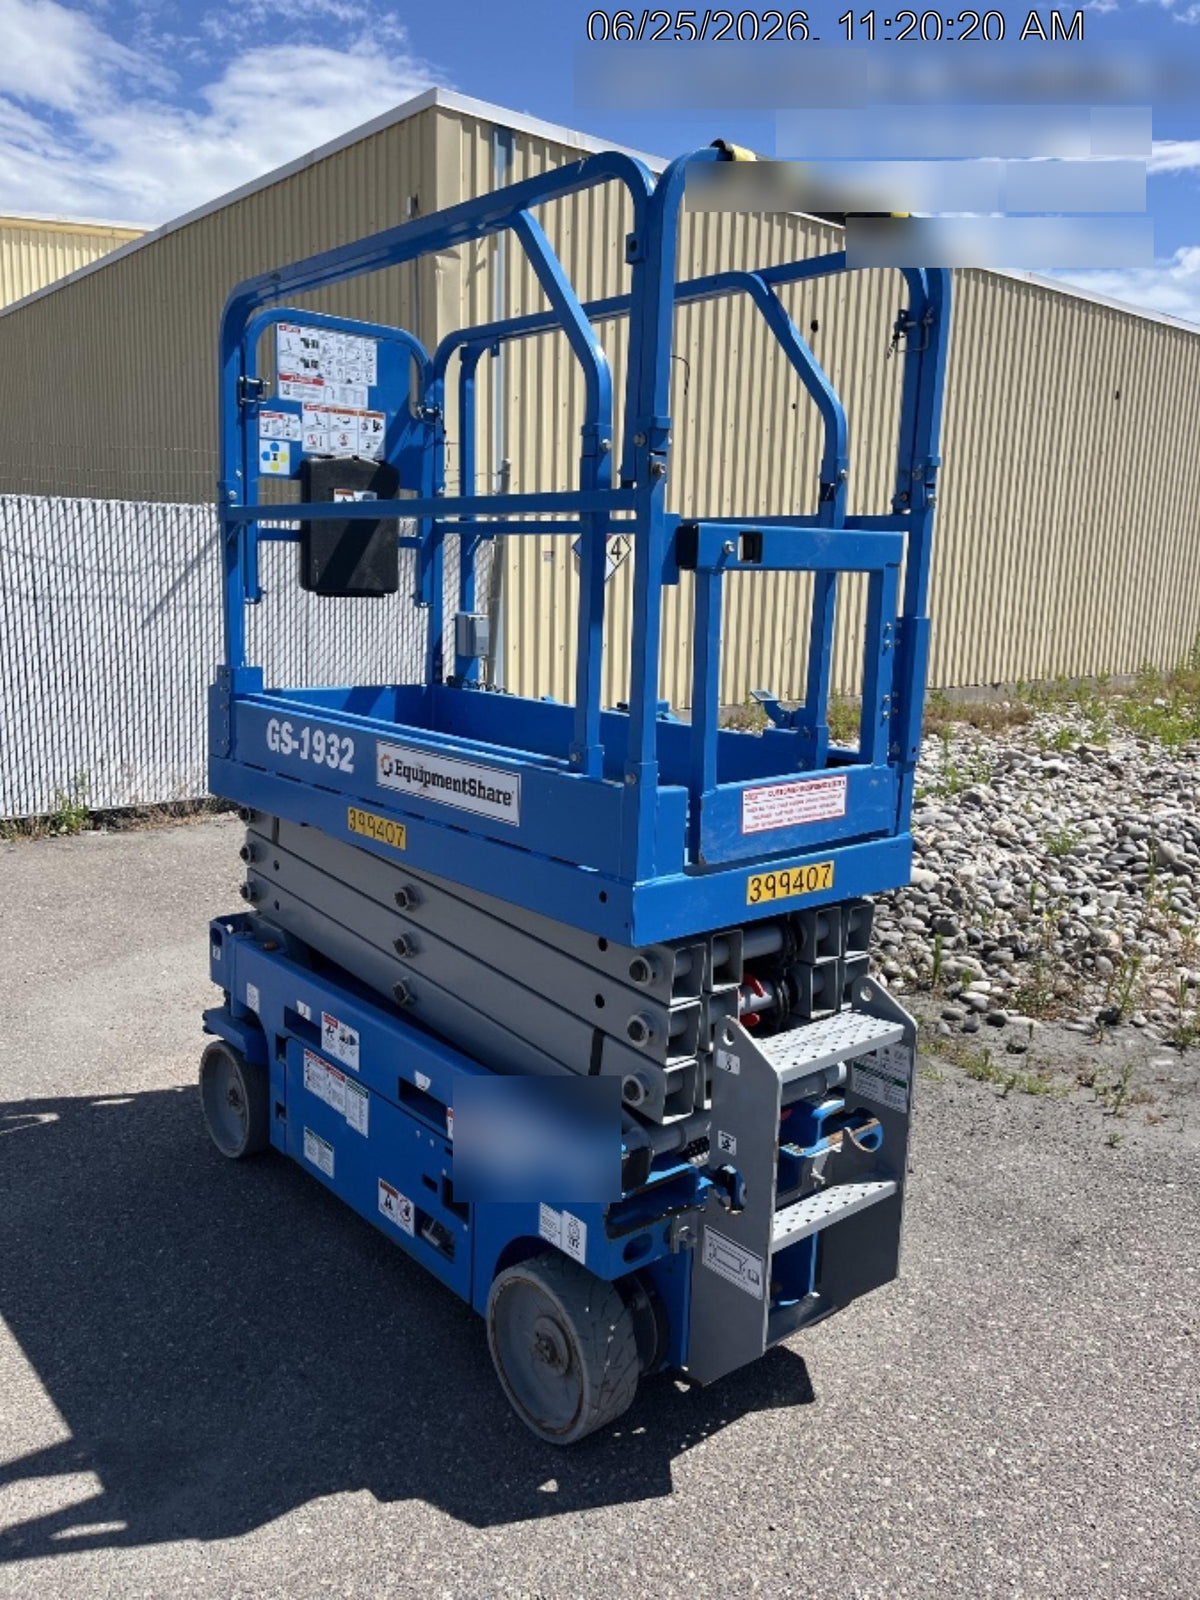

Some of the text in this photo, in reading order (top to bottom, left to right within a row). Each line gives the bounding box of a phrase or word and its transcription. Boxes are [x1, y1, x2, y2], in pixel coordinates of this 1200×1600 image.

[611, 536, 622, 560] 4
[266, 718, 354, 774] GS-1932
[394, 758, 512, 806] EquipmentShare
[349, 808, 405, 847] 399407
[749, 863, 832, 903] 399407
